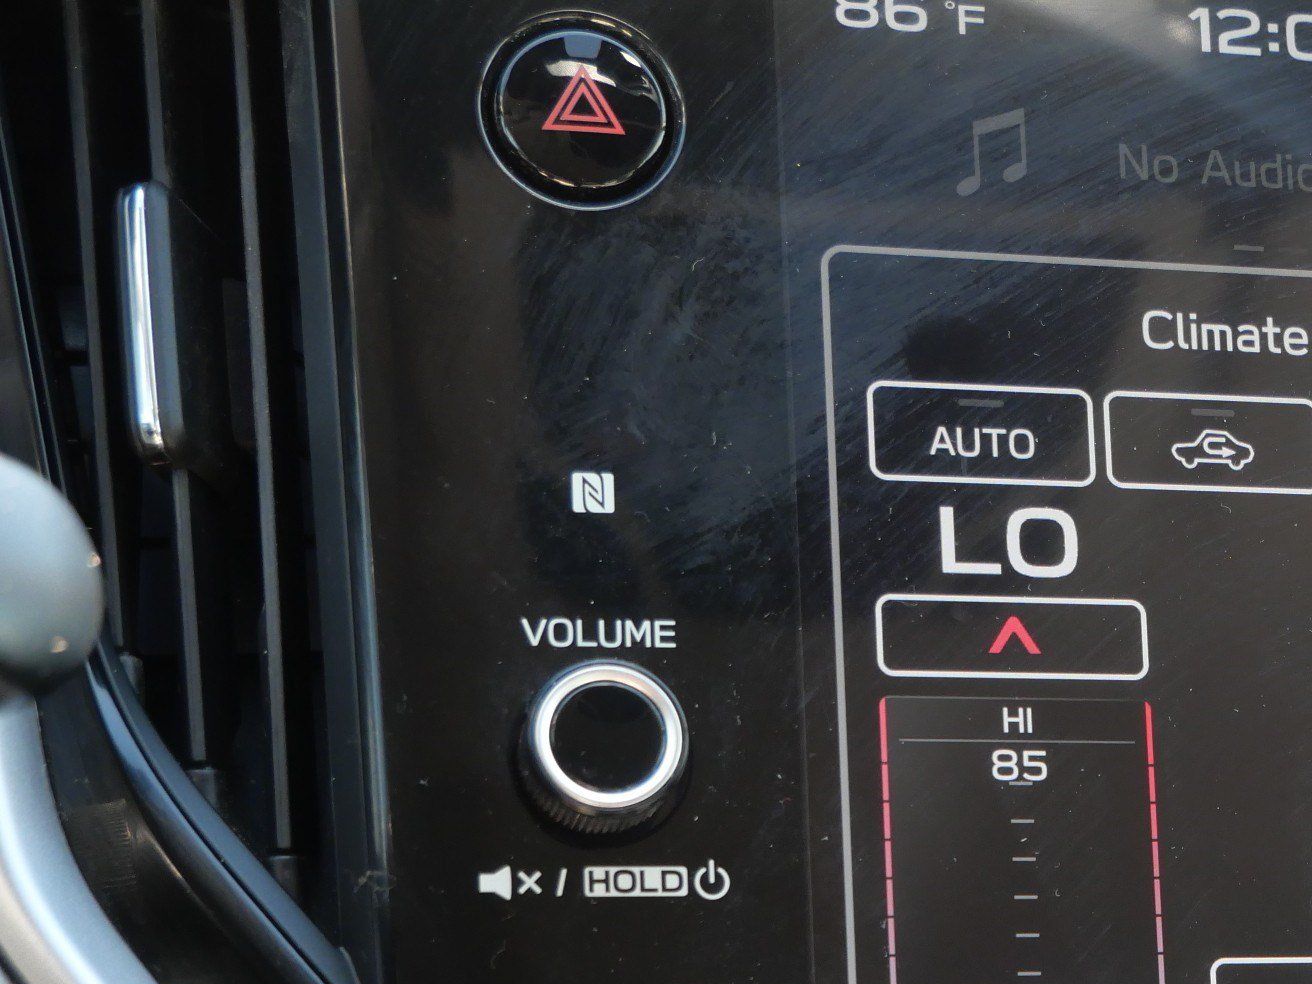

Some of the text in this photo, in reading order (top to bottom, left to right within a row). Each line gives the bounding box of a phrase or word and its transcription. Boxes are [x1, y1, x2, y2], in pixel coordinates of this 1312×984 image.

[1119, 141, 1178, 183] No
[1142, 310, 1308, 356] Climate
[930, 427, 1034, 459] AUTO
[940, 506, 1078, 578] LO
[522, 618, 676, 648] VOLUME
[1003, 707, 1032, 733] HI
[992, 750, 1047, 781] 85
[588, 870, 684, 894] HOLD
